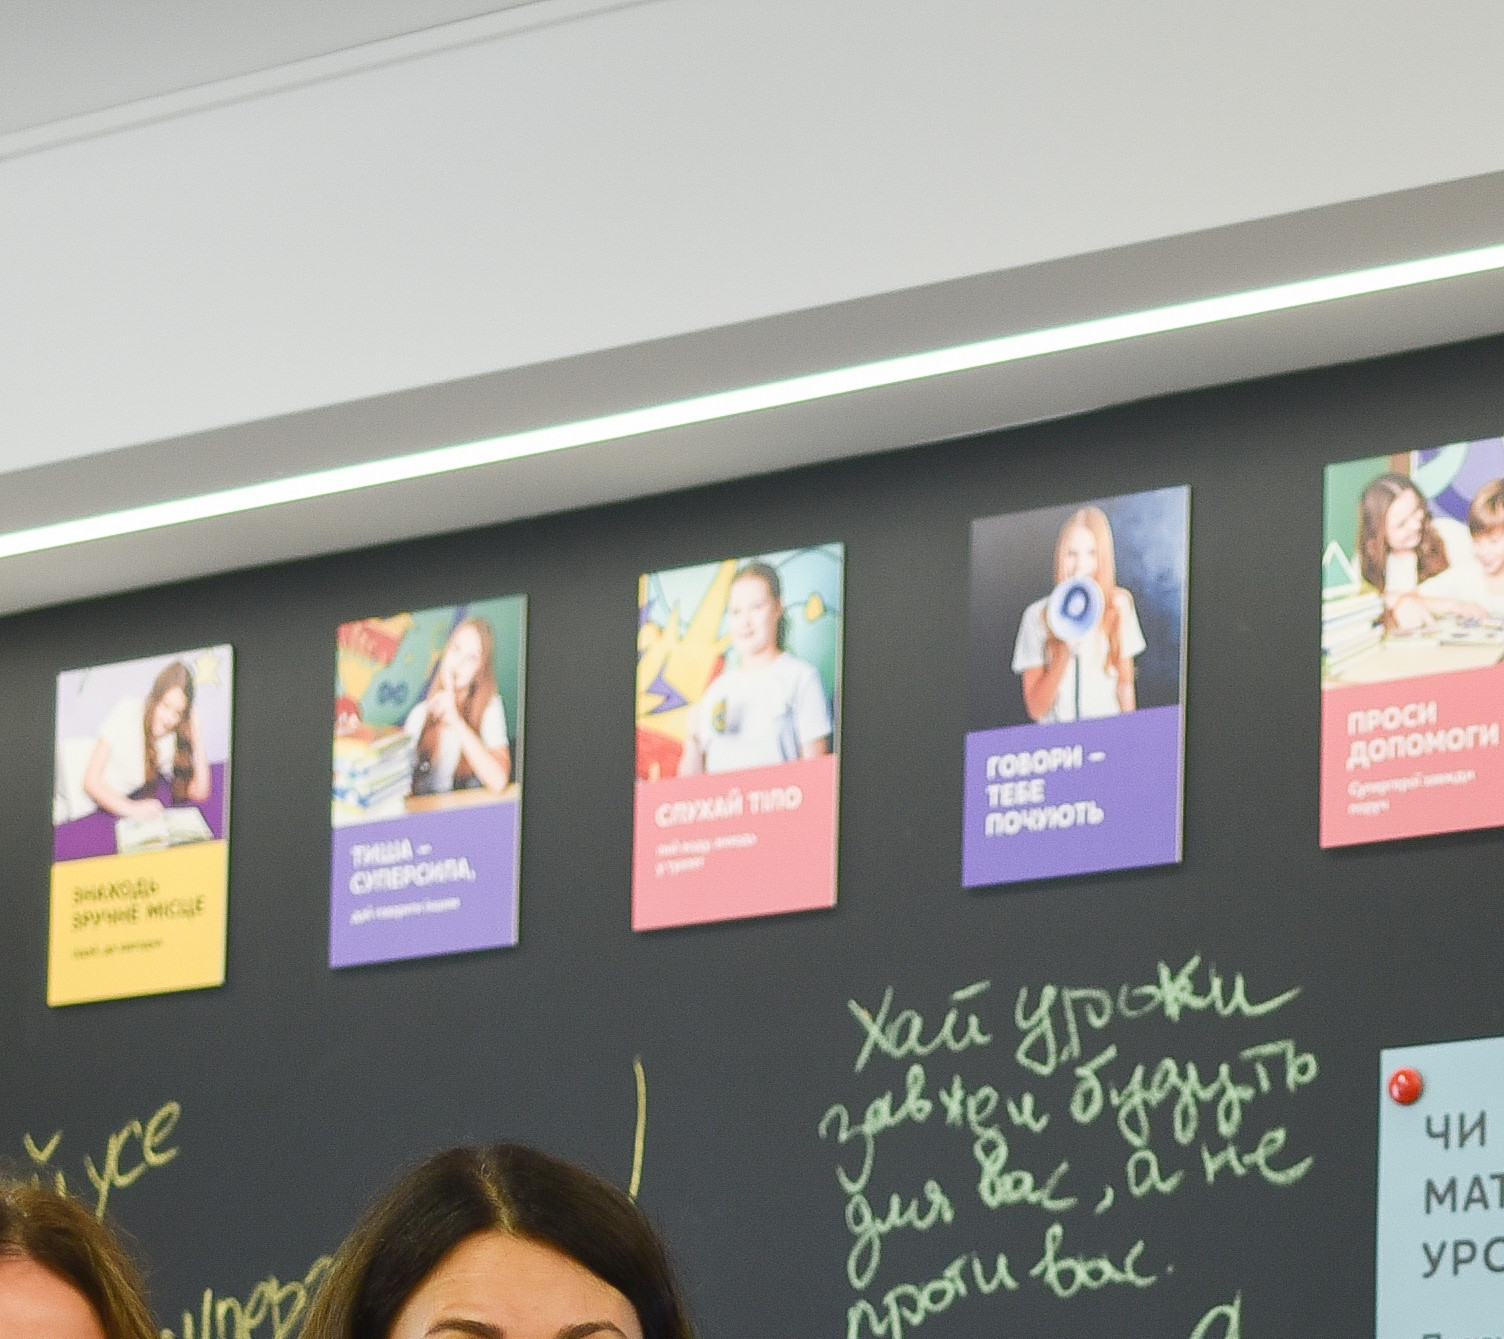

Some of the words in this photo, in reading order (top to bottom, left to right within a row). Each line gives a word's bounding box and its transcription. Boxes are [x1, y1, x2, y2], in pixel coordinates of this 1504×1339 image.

[1346, 701, 1438, 736] ПРОСИ
[986, 744, 1083, 781] ГОВОРИ
[1345, 723, 1500, 772] ДОПОМОГИ
[654, 786, 744, 829] СЛУХАЙ
[749, 784, 804, 815] ТІЛО
[986, 778, 1046, 809] ТЕБЕ
[984, 800, 1105, 839] ПОЧУЮТЬ
[350, 838, 414, 870] ТИША
[848, 981, 992, 1073] Хай
[1014, 955, 1303, 1076] уроки
[1071, 1041, 1320, 1147] будуть
[1424, 1109, 1488, 1150] ЧИ
[845, 1180, 954, 1290] для
[1126, 1148, 1185, 1197] а
[1200, 1128, 1314, 1184] не
